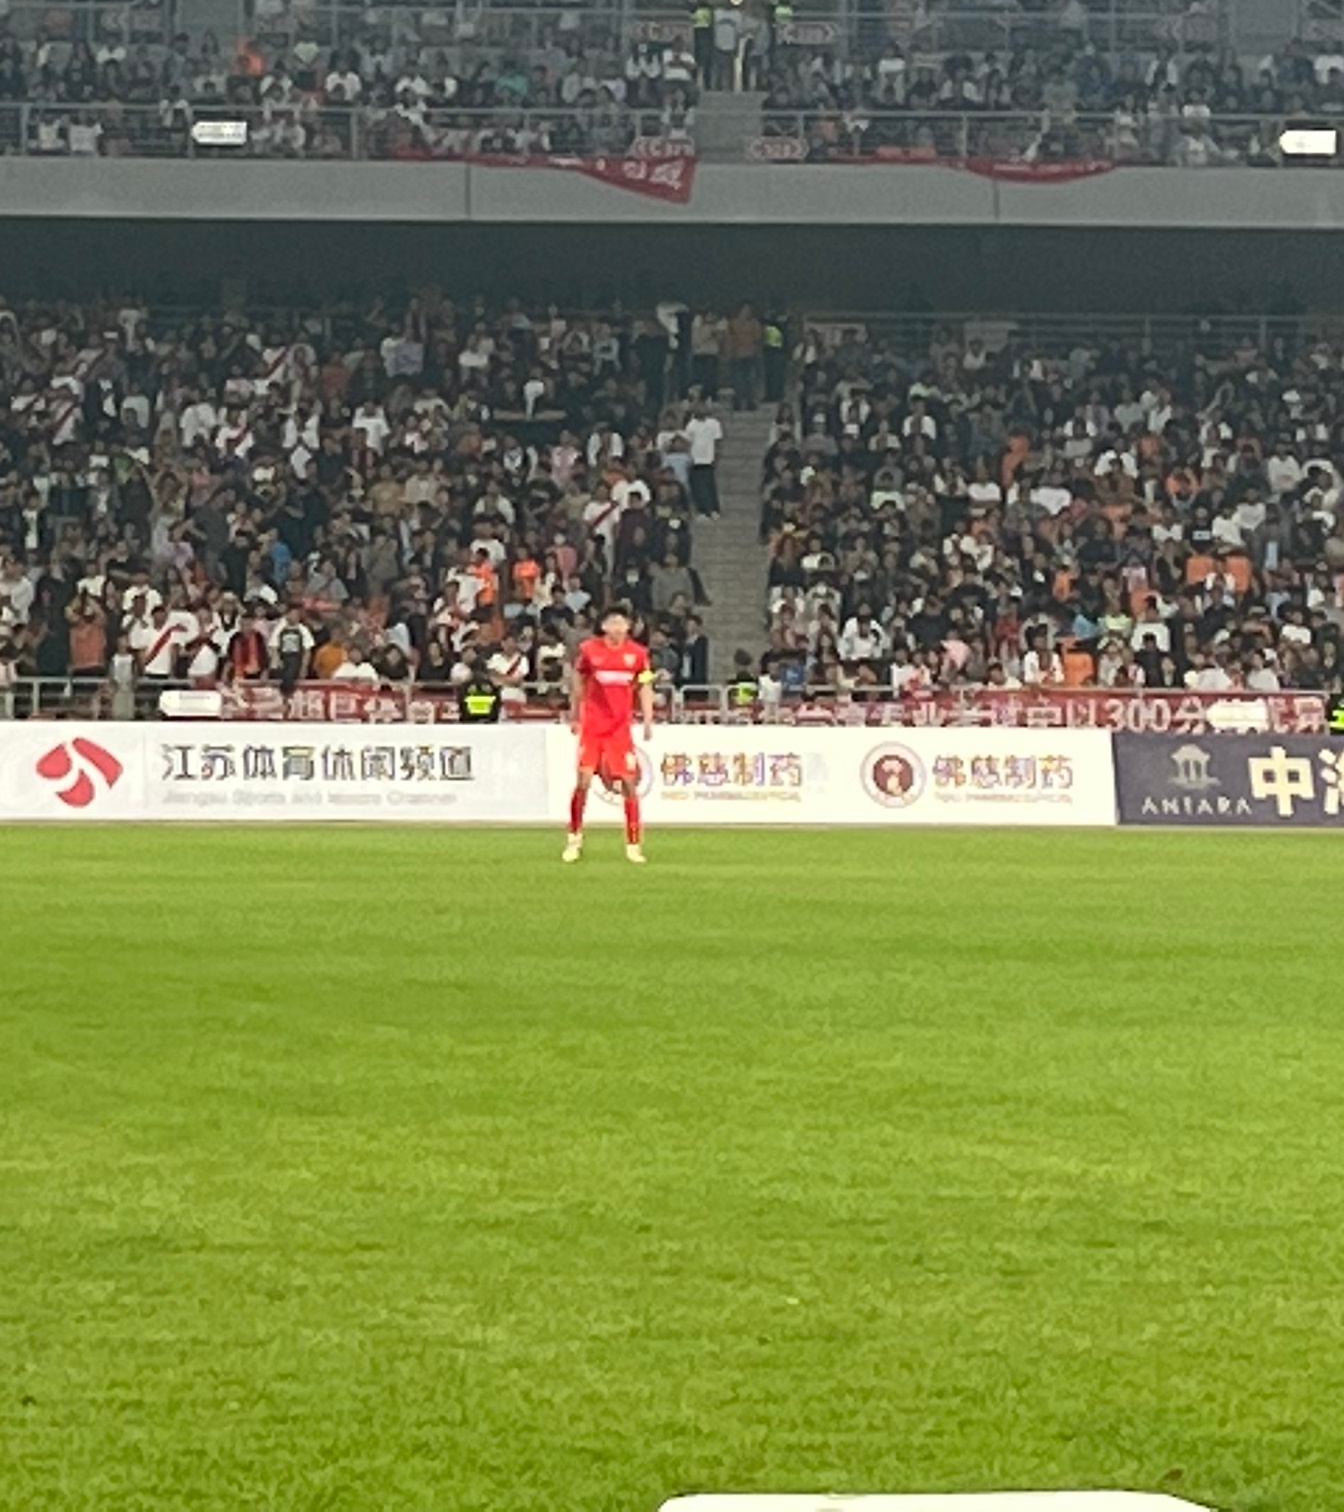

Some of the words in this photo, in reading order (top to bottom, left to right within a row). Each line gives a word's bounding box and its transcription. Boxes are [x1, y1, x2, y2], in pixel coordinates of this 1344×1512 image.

[161, 743, 474, 781] 江苏体育休闲频道
[660, 751, 803, 787] 佛慈制药
[932, 753, 1073, 789] 佛慈制药
